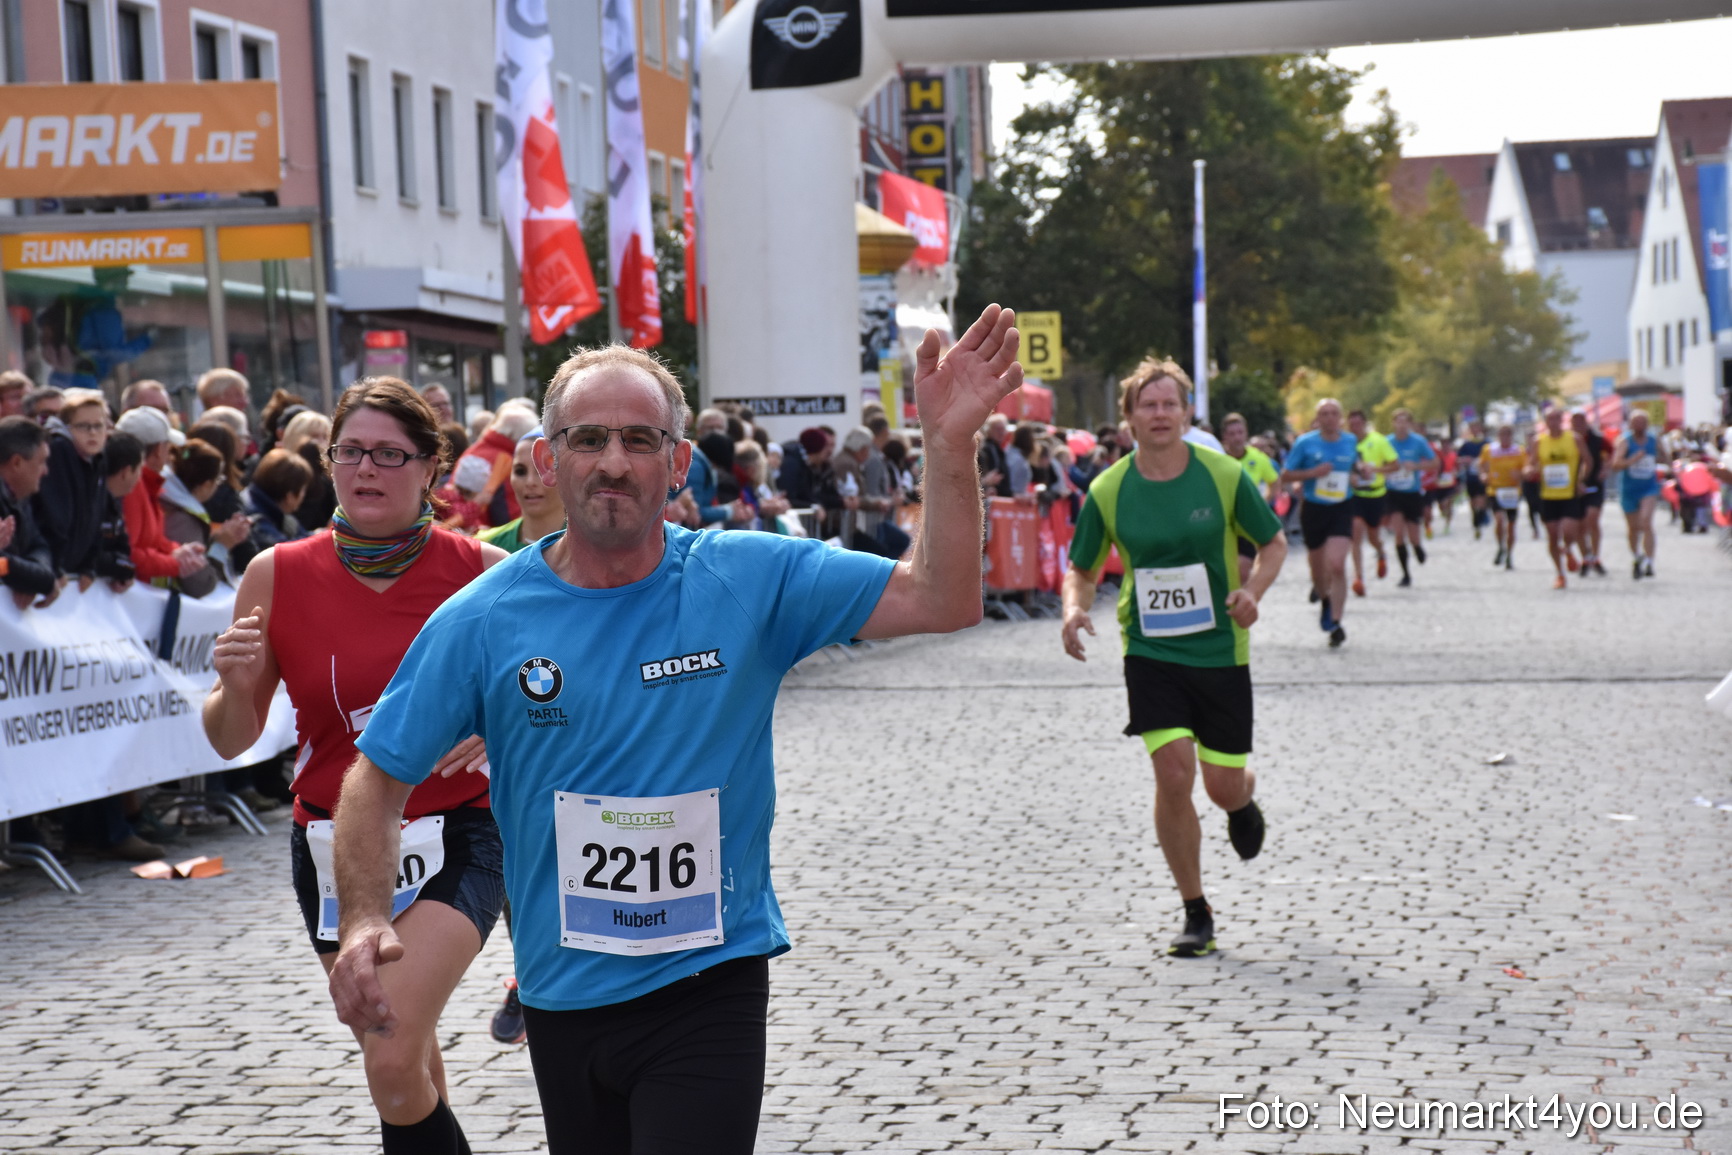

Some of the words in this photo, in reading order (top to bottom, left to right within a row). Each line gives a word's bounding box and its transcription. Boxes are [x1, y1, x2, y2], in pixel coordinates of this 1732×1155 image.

[21, 236, 189, 264] RUNMARKT.DE
[1029, 333, 1050, 364] B
[1148, 587, 1197, 610] 2761
[0, 648, 57, 701] BMW
[520, 659, 558, 676] BMW
[641, 650, 723, 682] BOCK
[643, 680, 670, 691] inspired
[699, 669, 728, 679] concepts
[527, 707, 568, 720] PARTL
[530, 719, 569, 728] Neumarkt
[2, 709, 65, 747] WENIGER
[616, 811, 675, 826] BOCK
[582, 842, 696, 893] 2216
[568, 879, 574, 889] C
[613, 909, 667, 928] Hubert
